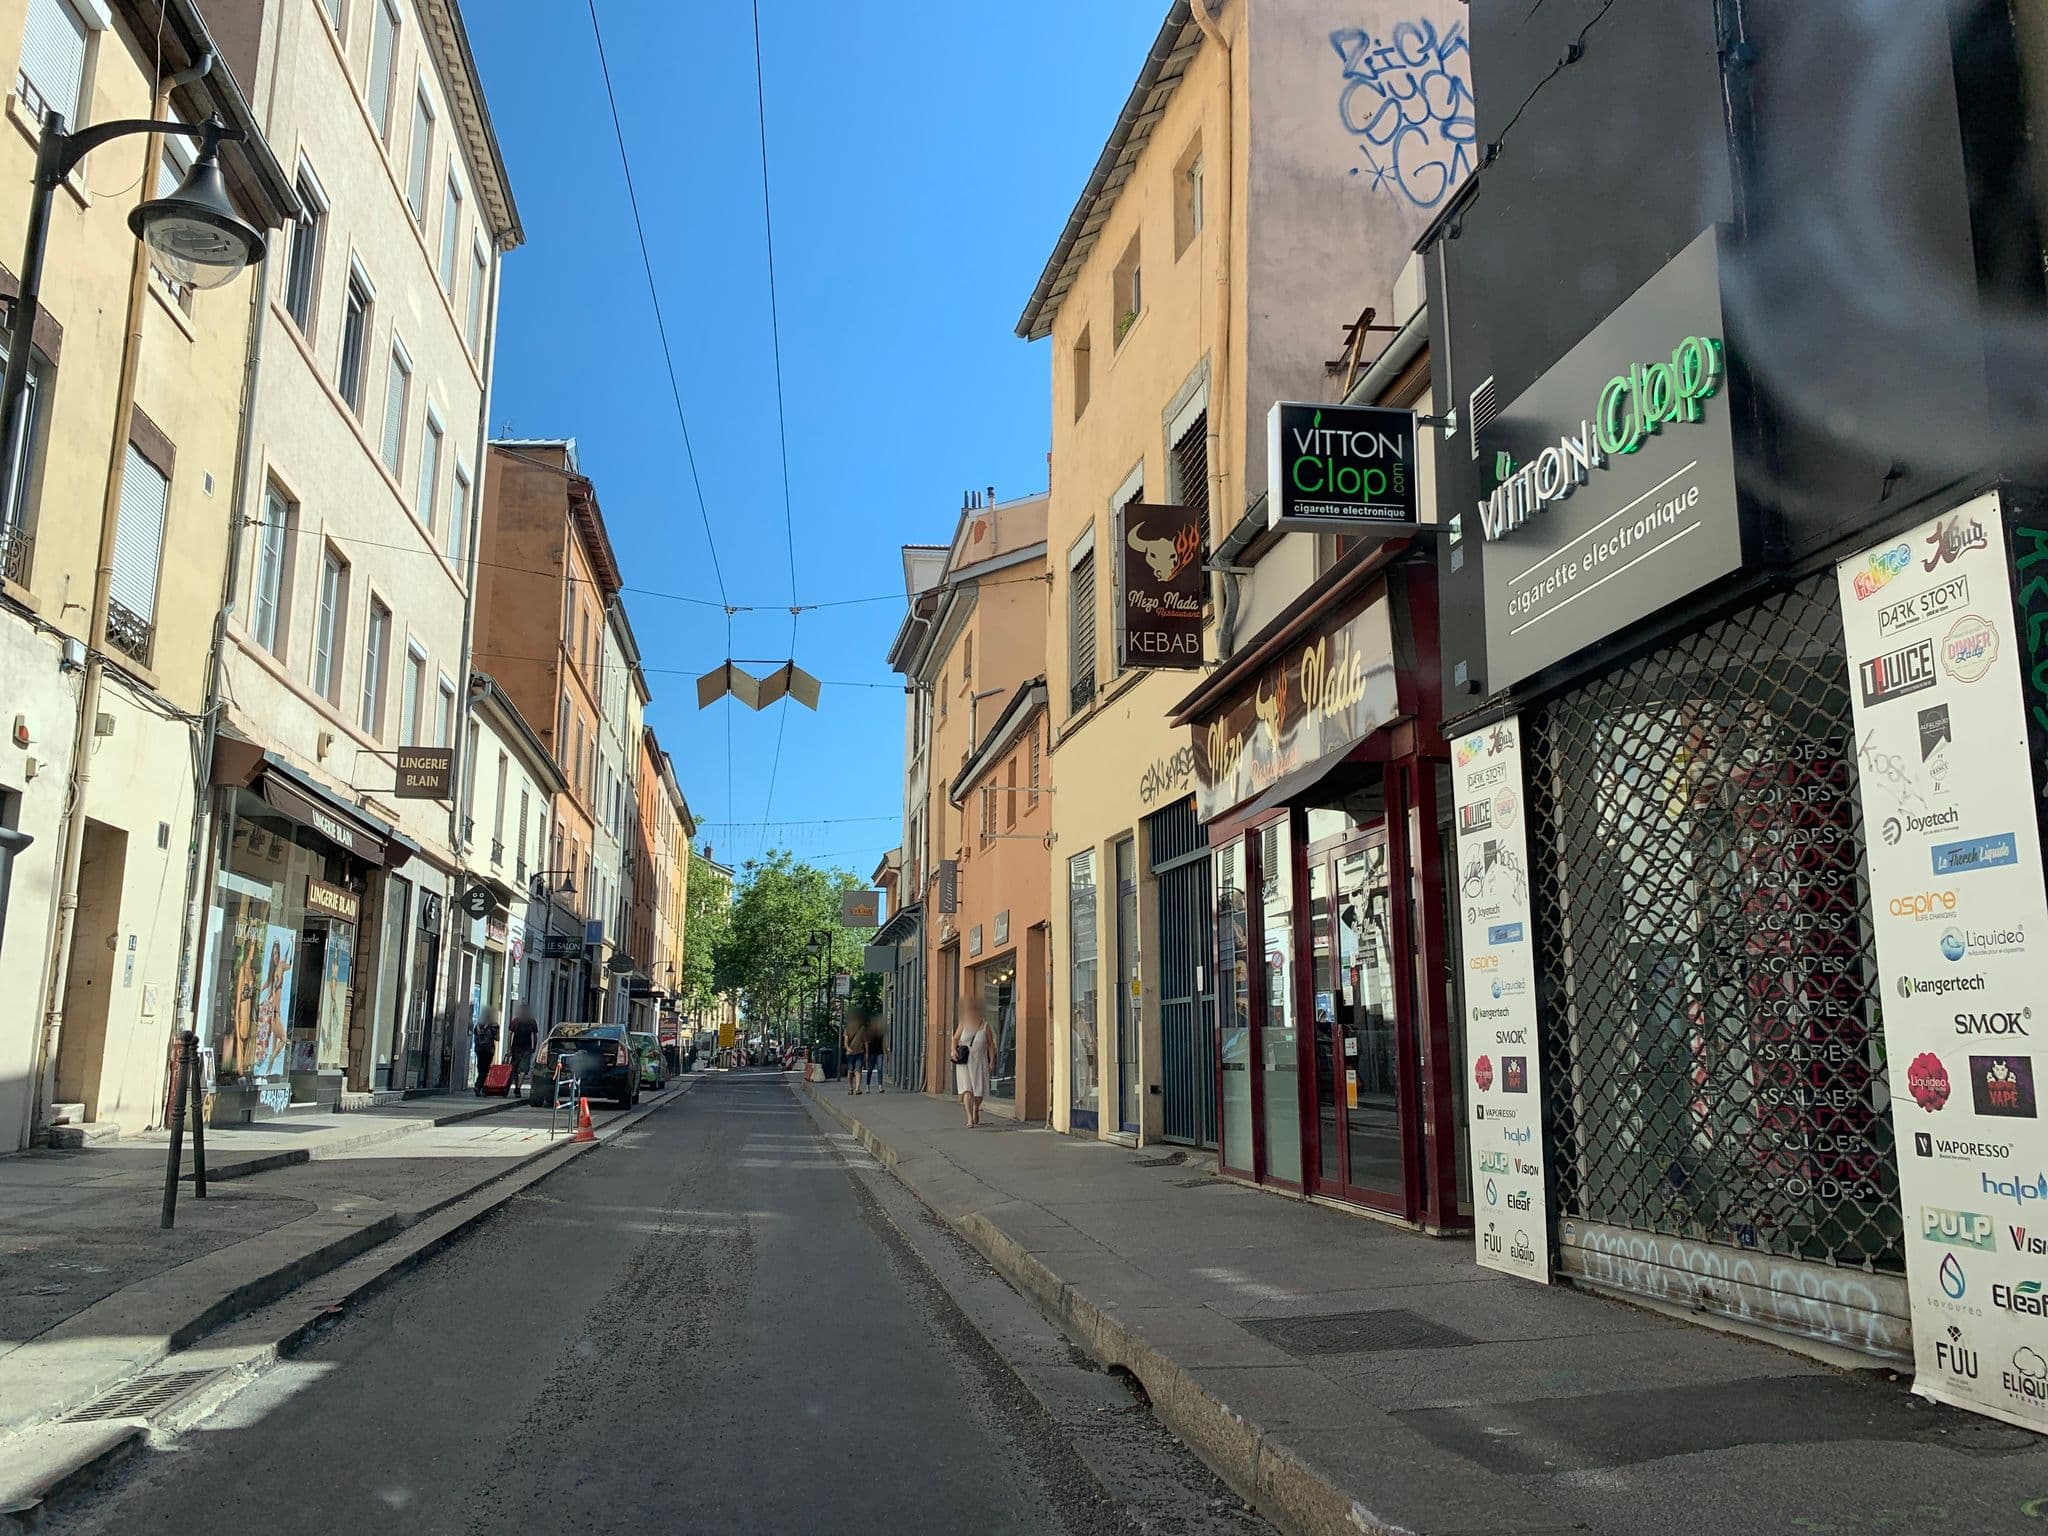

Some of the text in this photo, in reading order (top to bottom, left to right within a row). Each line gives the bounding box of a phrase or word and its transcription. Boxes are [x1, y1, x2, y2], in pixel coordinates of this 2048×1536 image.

[1293, 422, 1403, 460] VITTON
[1478, 336, 1718, 541] VITTON Clop
[1293, 456, 1405, 503] Clop .com
[1294, 504, 1405, 518] cigarette electronique
[1508, 486, 1699, 617] cigarette electronique
[1128, 590, 1199, 613] Mezo Mada
[1155, 606, 1200, 618] Restaurant
[1880, 599, 1916, 629] DARK
[1920, 579, 1966, 612] STORY
[1130, 631, 1200, 654] KEBAB
[1948, 630, 1992, 660] DINNER
[1207, 631, 1367, 799] Mezo Mada
[400, 757, 448, 770] LINGERIE
[1485, 765, 1506, 782] STORY
[406, 775, 439, 787] BLAIN
[312, 809, 353, 849] LINGERIE BLAIN
[1905, 806, 1959, 832] Joyetech
[310, 884, 356, 918] LINGERIE BLAIN
[1889, 891, 1957, 922] aspire
[1757, 913, 1843, 931] SODES
[557, 942, 581, 950] SALON
[1966, 930, 2026, 949] Liquideo
[1913, 974, 1985, 996] kangertech
[1479, 1006, 1510, 1020] kangertech
[1954, 1012, 2029, 1036] SMOK
[1496, 1030, 1526, 1045] SMOK
[1910, 1075, 1947, 1090] Liquideo
[1485, 1108, 1517, 1118] VAPORESSO
[1503, 1127, 1528, 1146] halo
[1936, 1139, 2010, 1159] VAPORESSO
[1479, 1153, 1509, 1173] PULP
[1514, 1157, 1539, 1177] VISION
[1981, 1172, 2039, 1206] halo
[1507, 1194, 1531, 1212] Eleaf
[1923, 1207, 1991, 1245] PULP
[1484, 1233, 1502, 1253] FUU
[2009, 1225, 2048, 1255] VISI
[1510, 1246, 1535, 1262] ELIQUID
[1936, 1341, 1978, 1379] FUU
[2003, 1371, 2048, 1400] ELIQU
